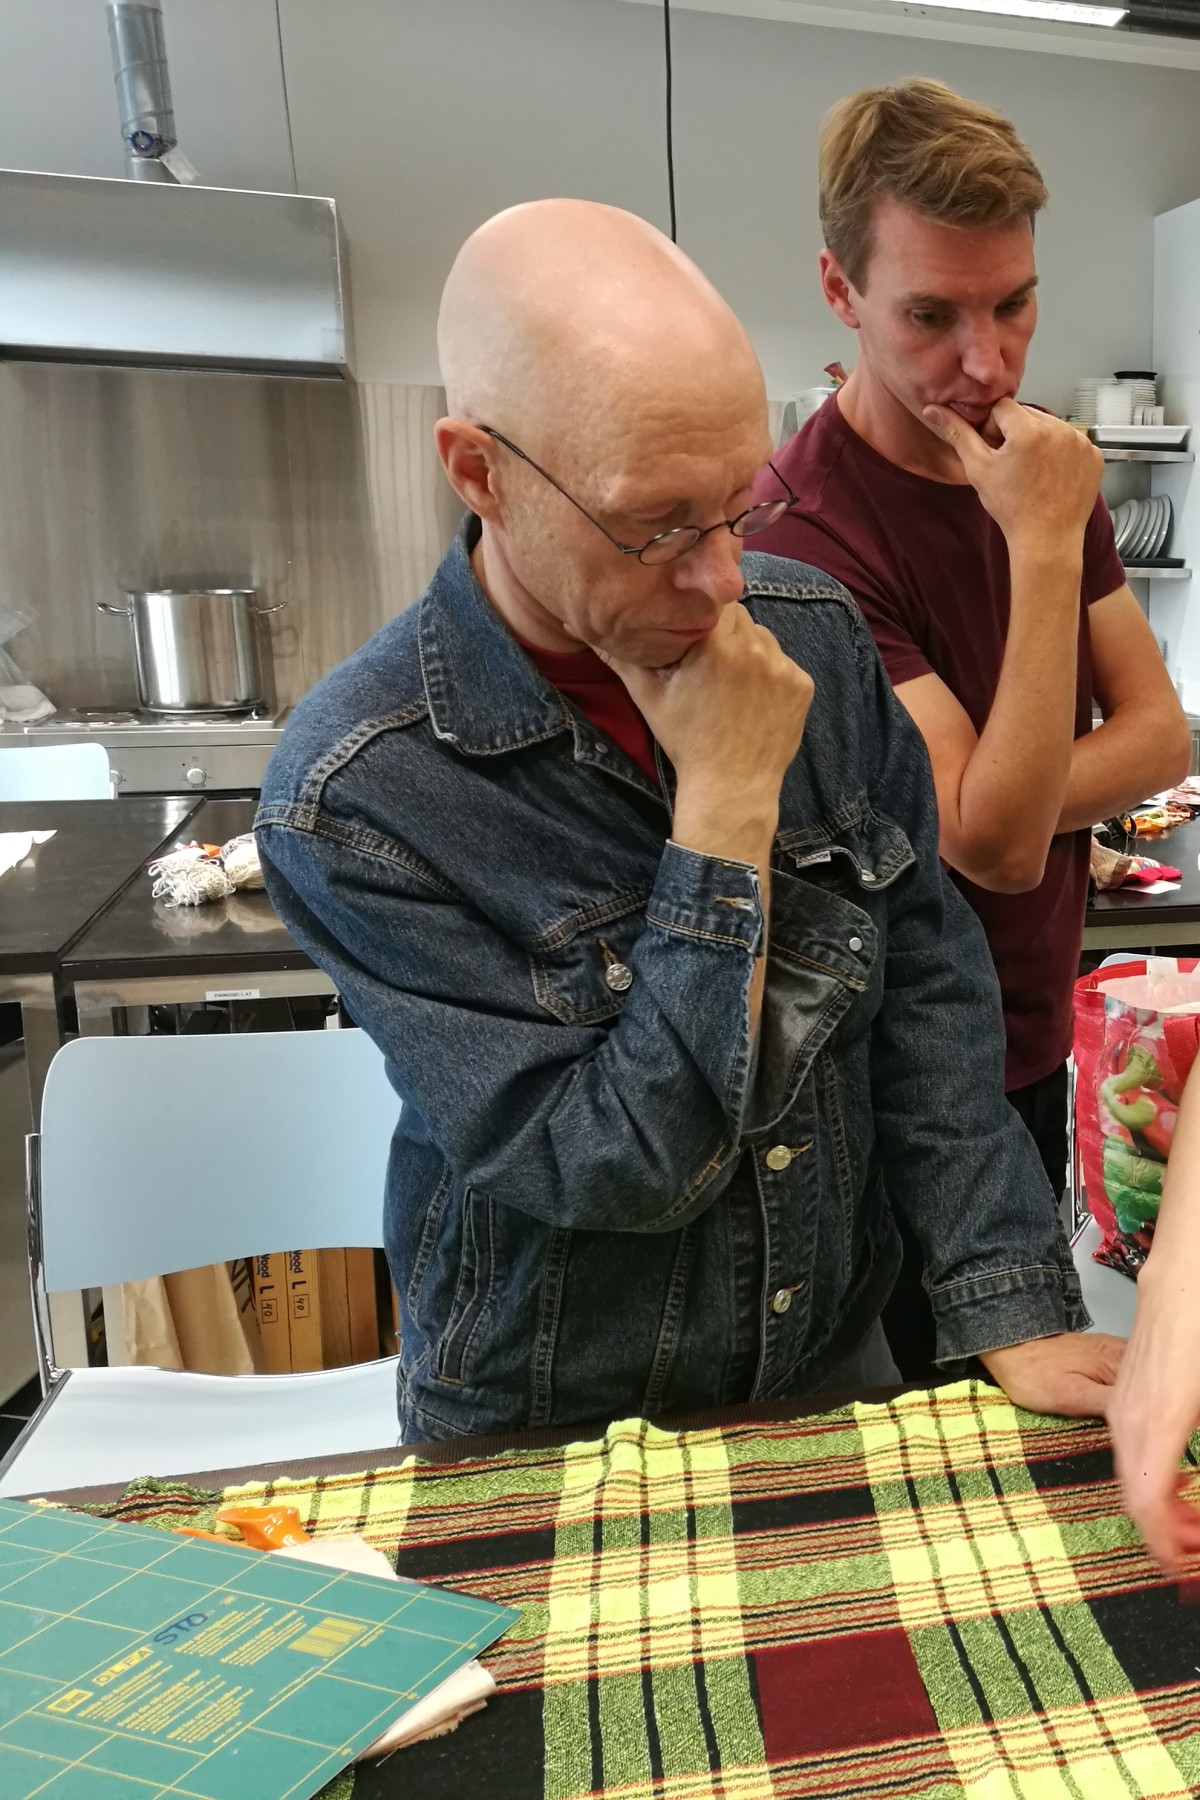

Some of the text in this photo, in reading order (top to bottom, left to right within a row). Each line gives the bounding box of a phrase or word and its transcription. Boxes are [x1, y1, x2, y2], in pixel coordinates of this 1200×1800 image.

[260, 1285, 274, 1294] L
[292, 1280, 307, 1290] L
[95, 1649, 152, 1684] OLFA
